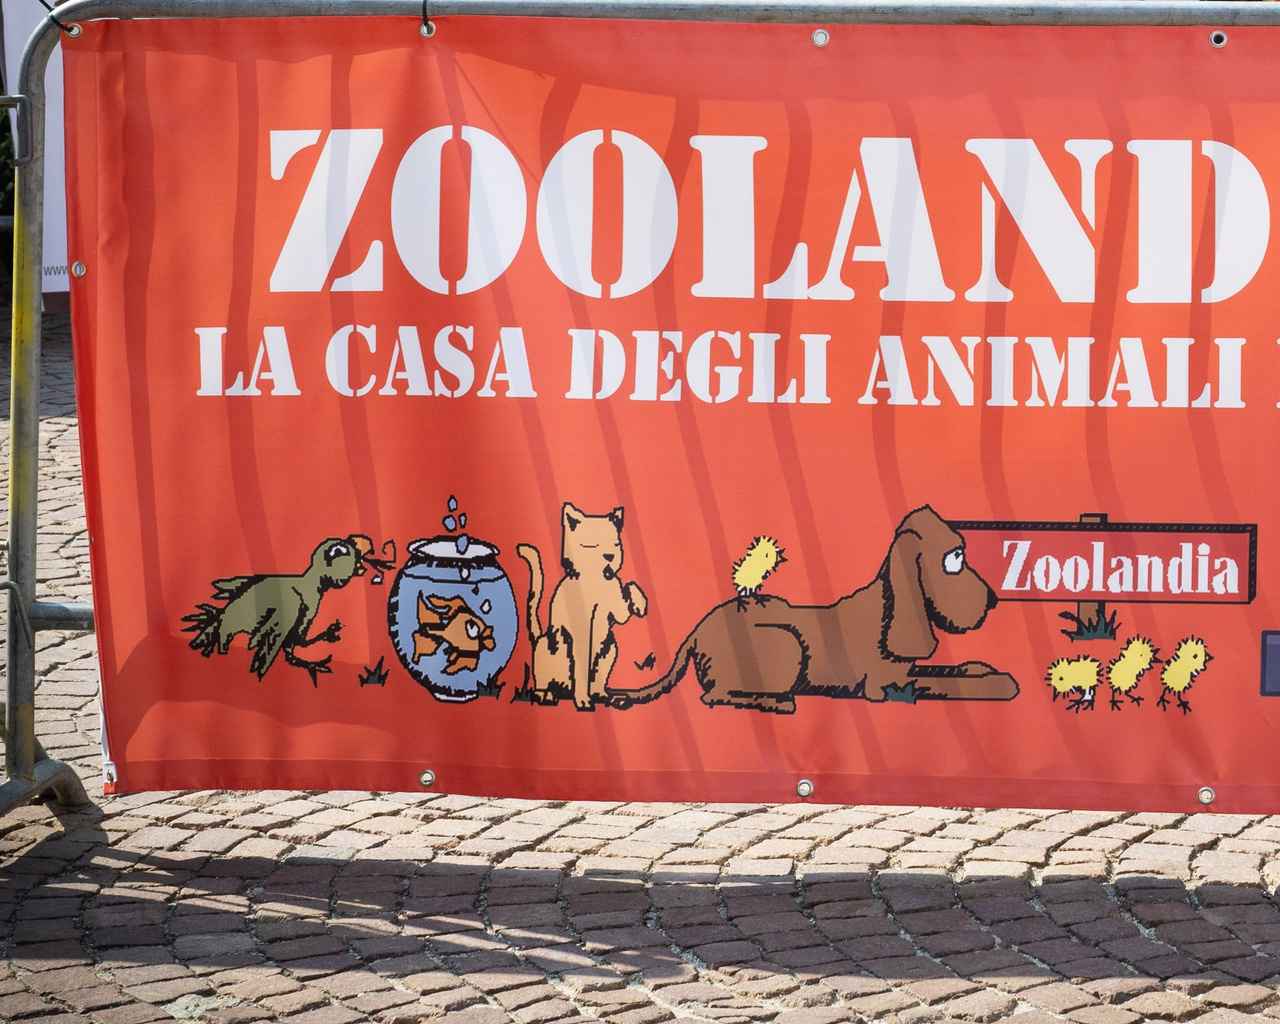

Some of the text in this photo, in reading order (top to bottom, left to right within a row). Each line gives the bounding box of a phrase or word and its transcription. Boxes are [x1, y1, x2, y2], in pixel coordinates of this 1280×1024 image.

[195, 326, 301, 397] LA
[325, 324, 538, 399] CASA
[565, 329, 831, 404] DEGLI
[858, 335, 1246, 408] ANIMALI
[1001, 540, 1240, 595] Zoolandia
